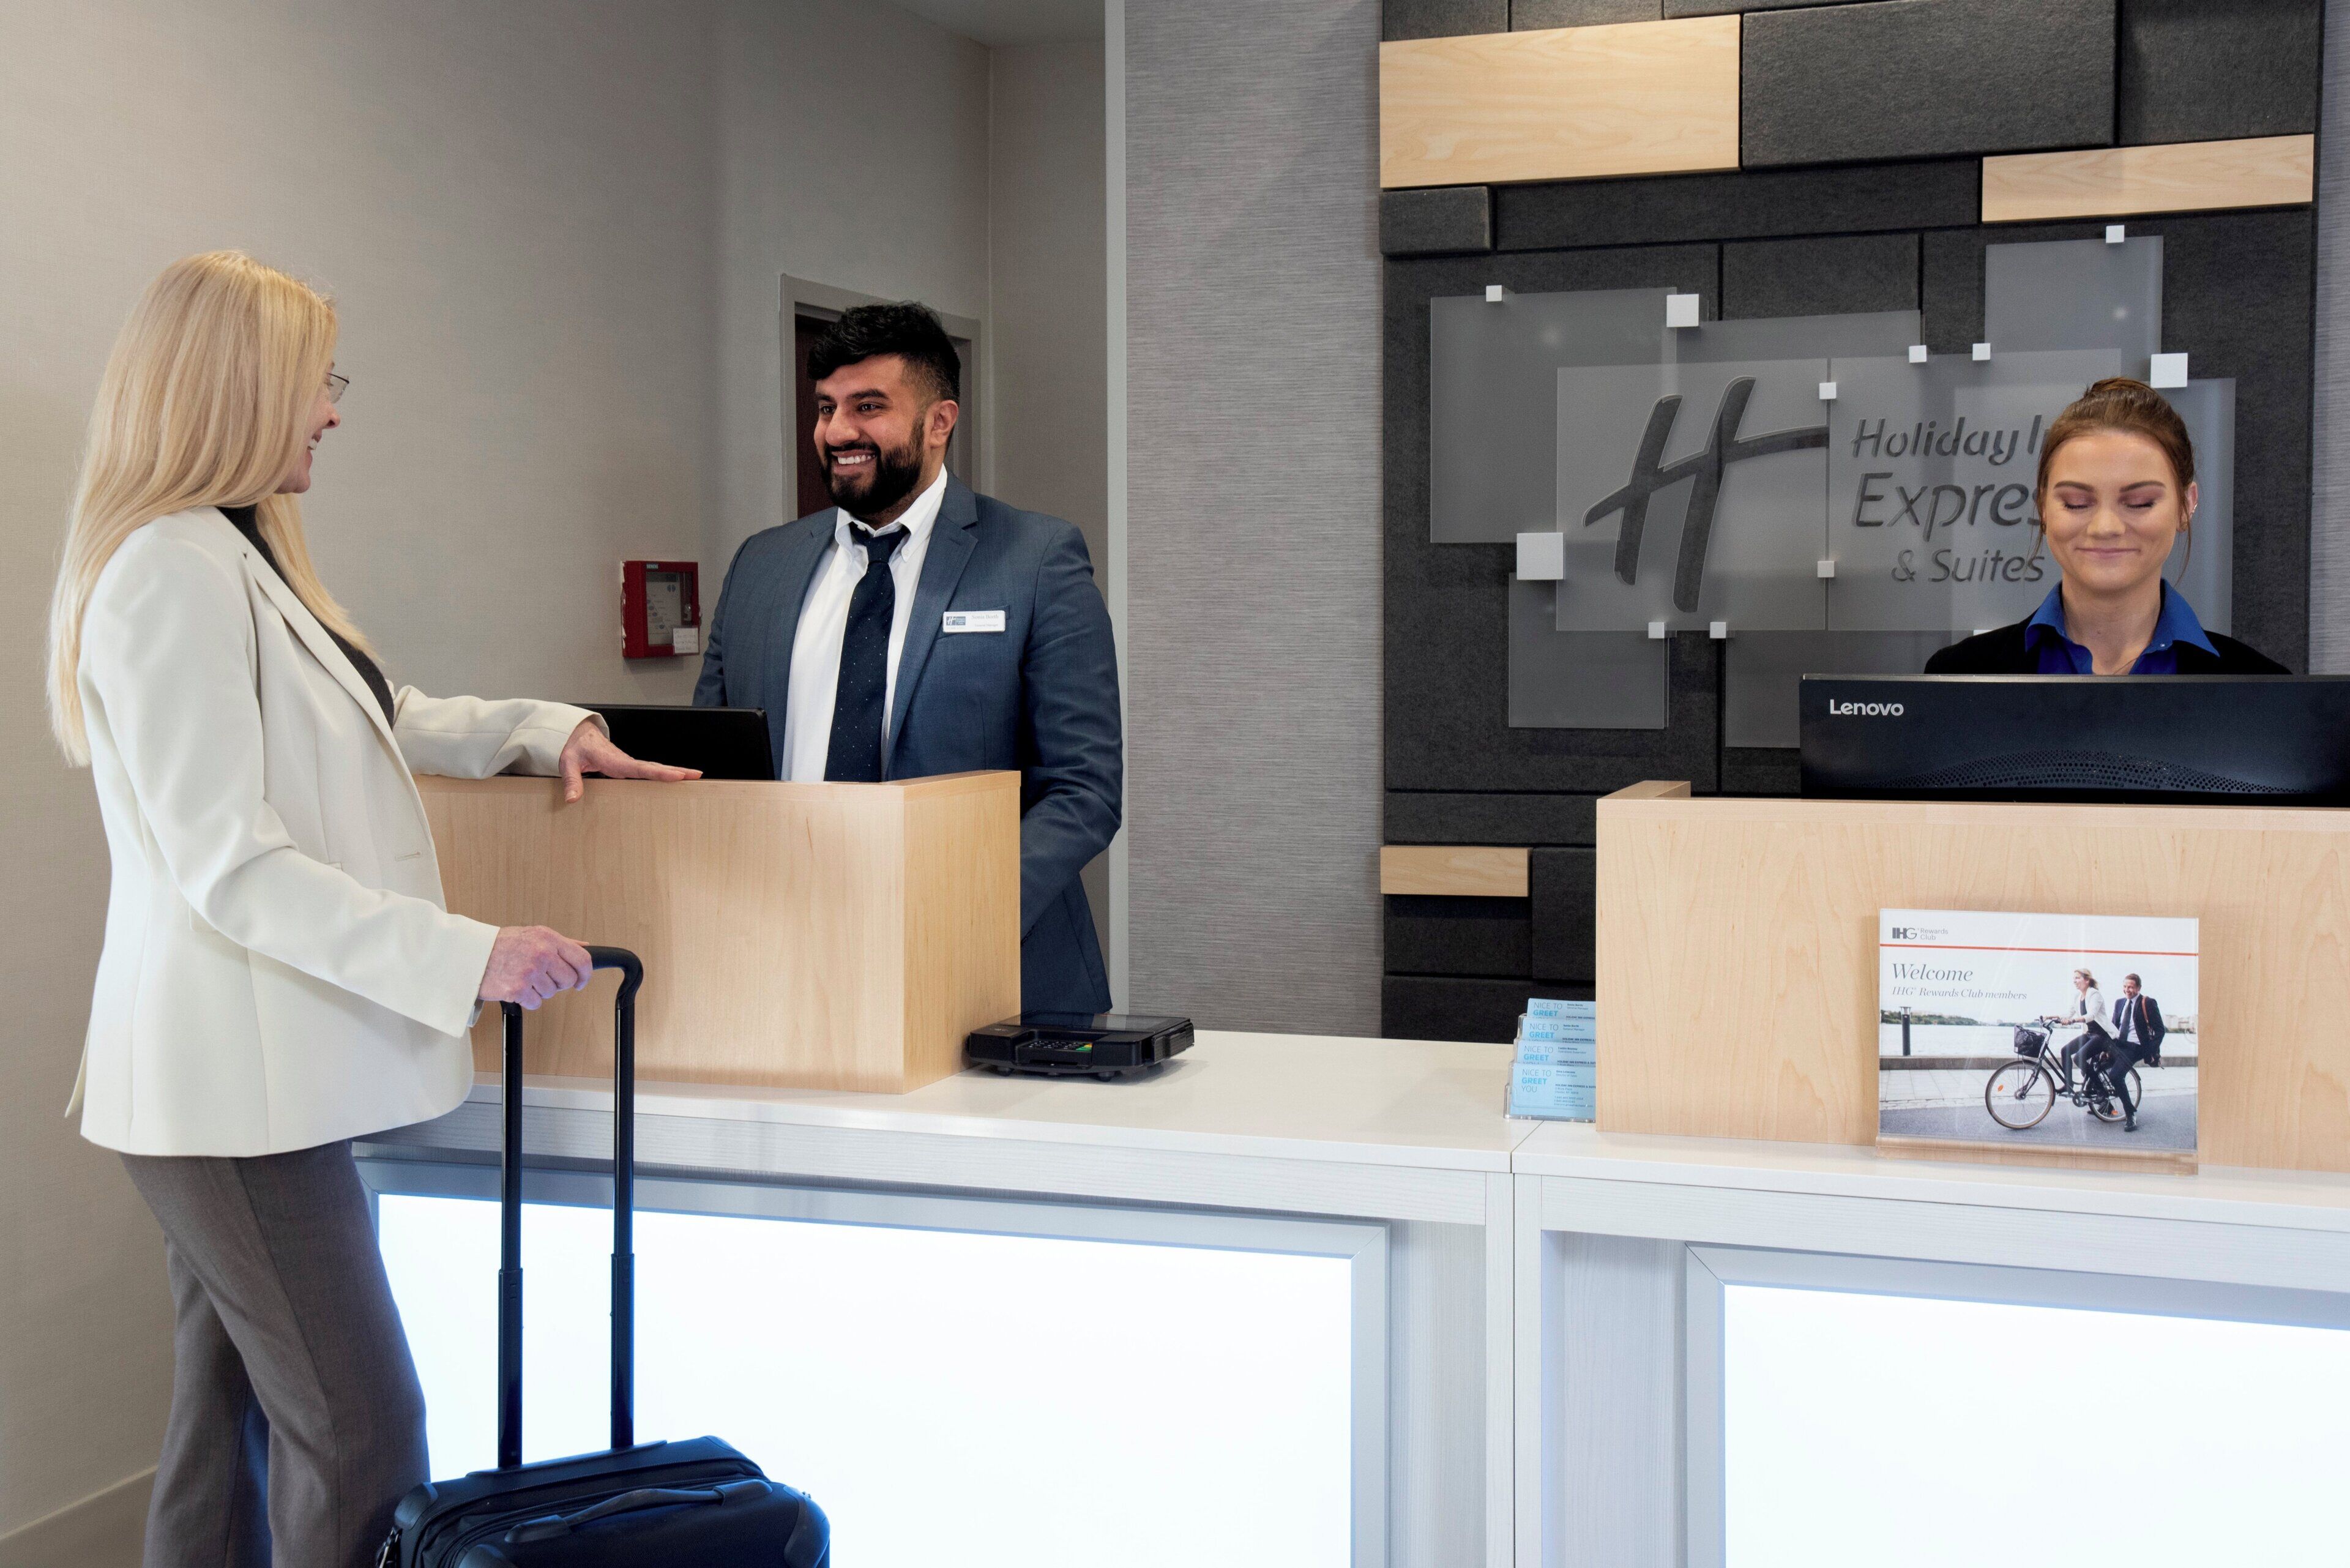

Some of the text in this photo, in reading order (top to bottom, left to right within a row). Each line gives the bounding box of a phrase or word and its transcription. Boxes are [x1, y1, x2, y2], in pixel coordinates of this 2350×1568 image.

[1851, 417, 2020, 466] Holiday
[1891, 548, 2045, 582] & Suites
[1830, 699, 1904, 716] Lenovo
[1892, 927, 1917, 940] IHG
[1892, 963, 1974, 981] Welcome
[1919, 987, 1958, 997] Rewards
[1961, 988, 1983, 998] Club
[1985, 991, 2027, 999] members
